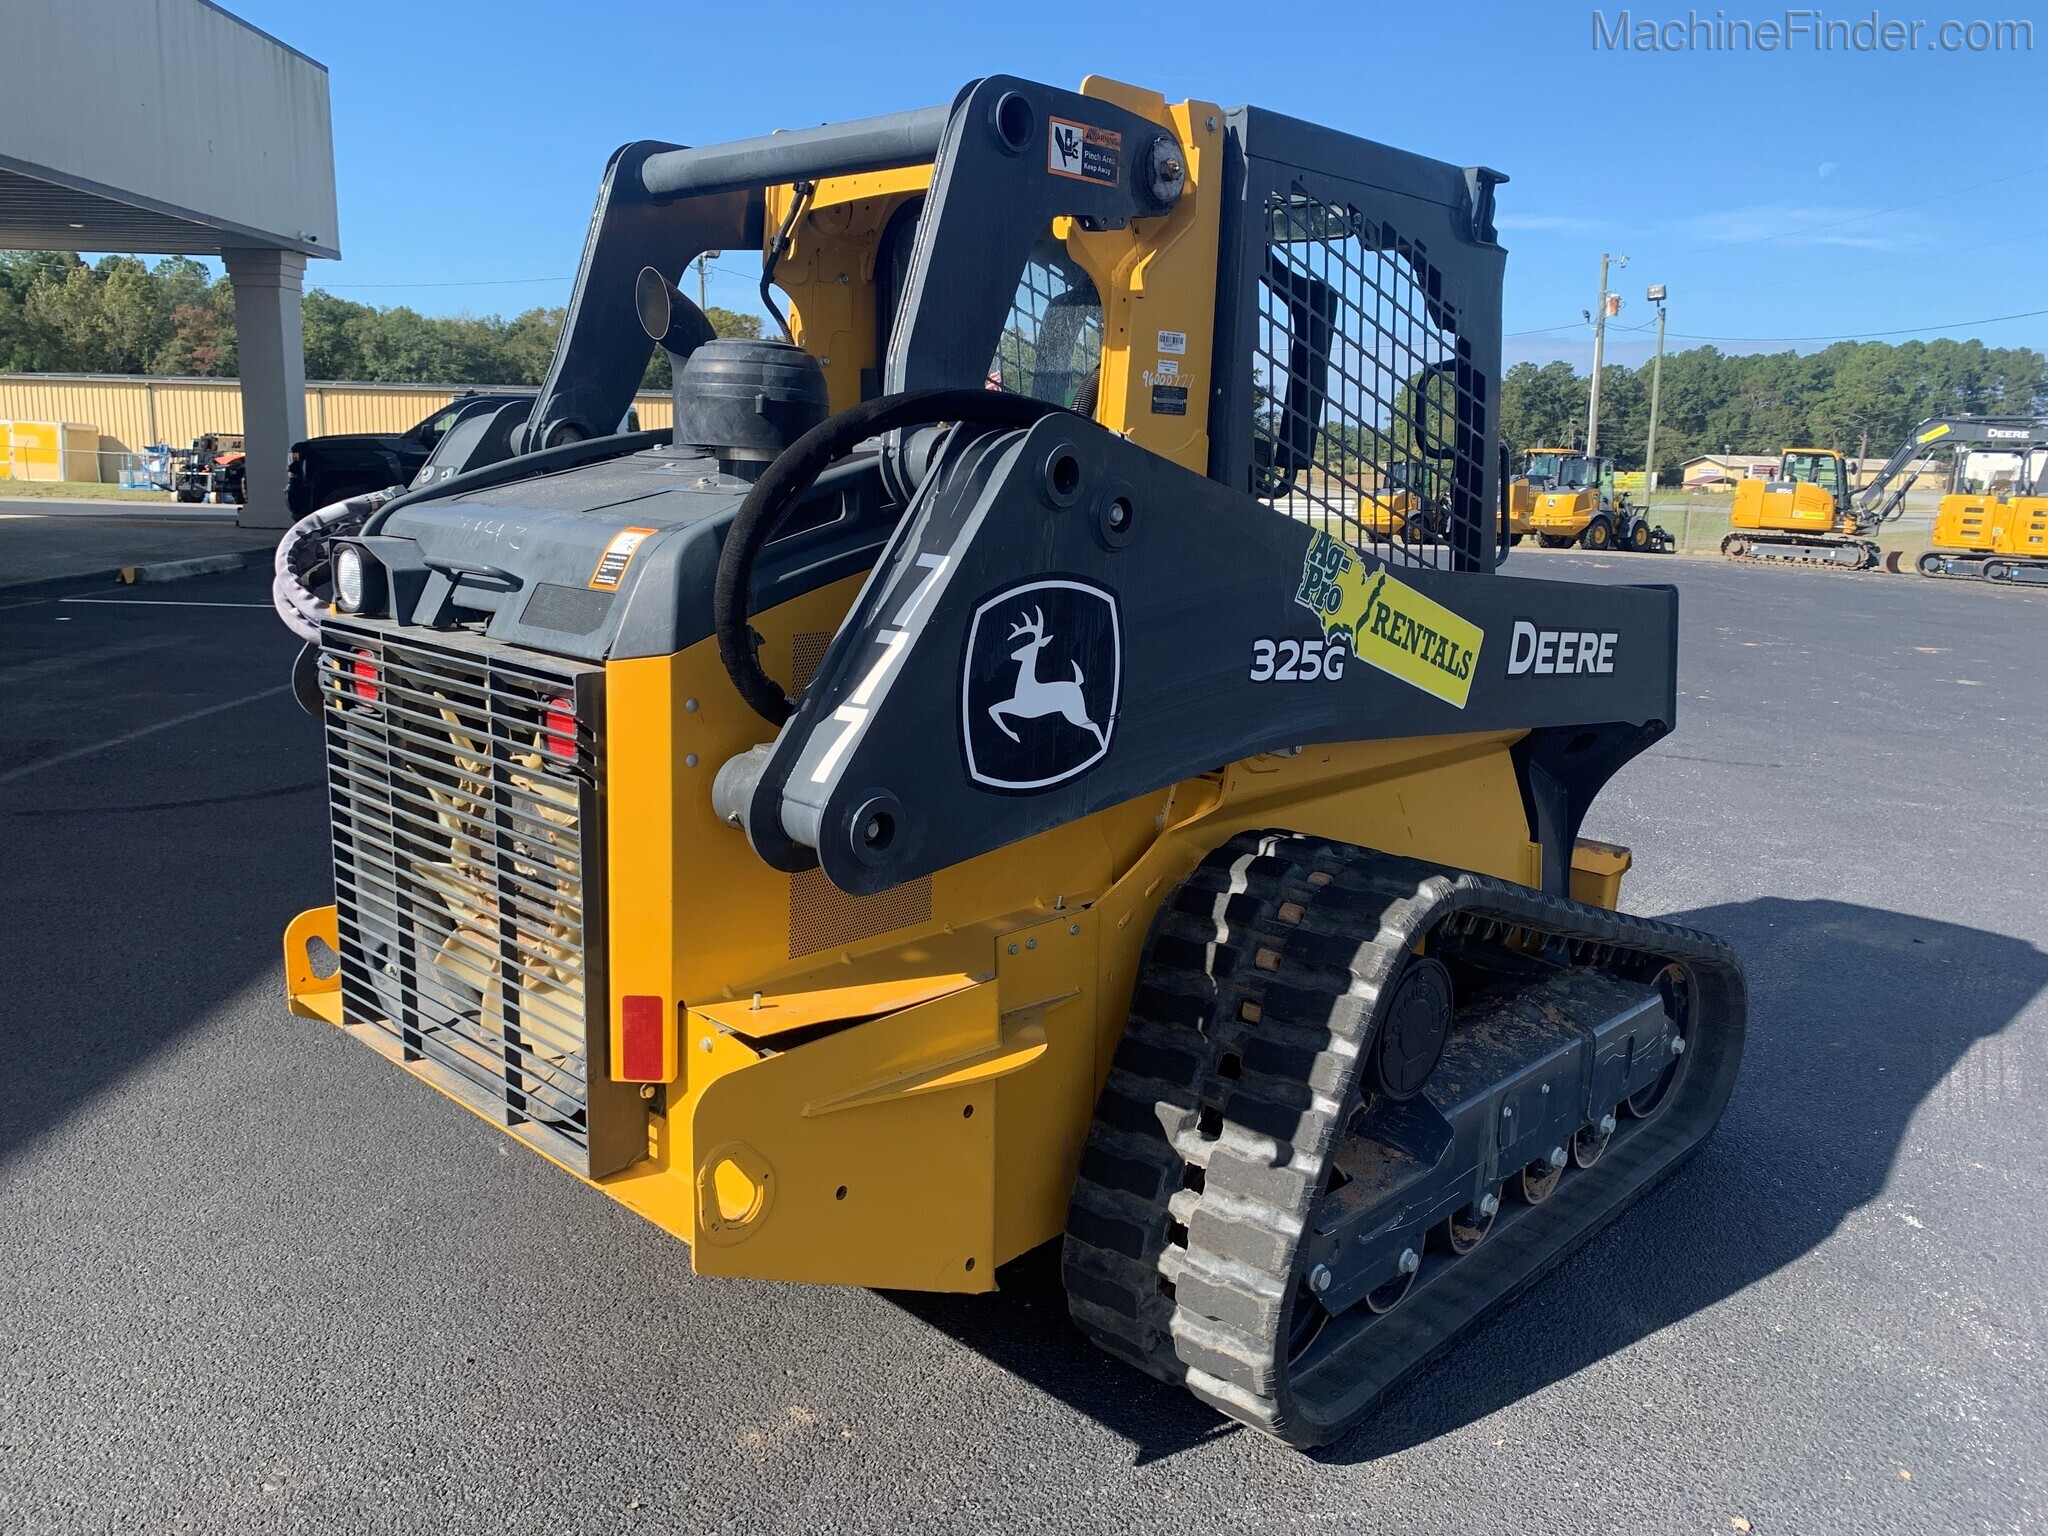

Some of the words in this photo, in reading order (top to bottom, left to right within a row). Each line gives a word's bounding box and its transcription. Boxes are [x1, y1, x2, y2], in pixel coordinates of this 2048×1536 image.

[1083, 162, 1098, 172] Keep
[1097, 166, 1112, 176] Away
[1084, 150, 1102, 161] Pinch
[1142, 369, 1195, 388] 96000777
[1987, 429, 2031, 439] DEERE
[1300, 562, 1343, 614] Pro
[1370, 601, 1473, 681] RENTALS
[1507, 621, 1618, 674] DEERE
[1250, 639, 1346, 681] 325G
